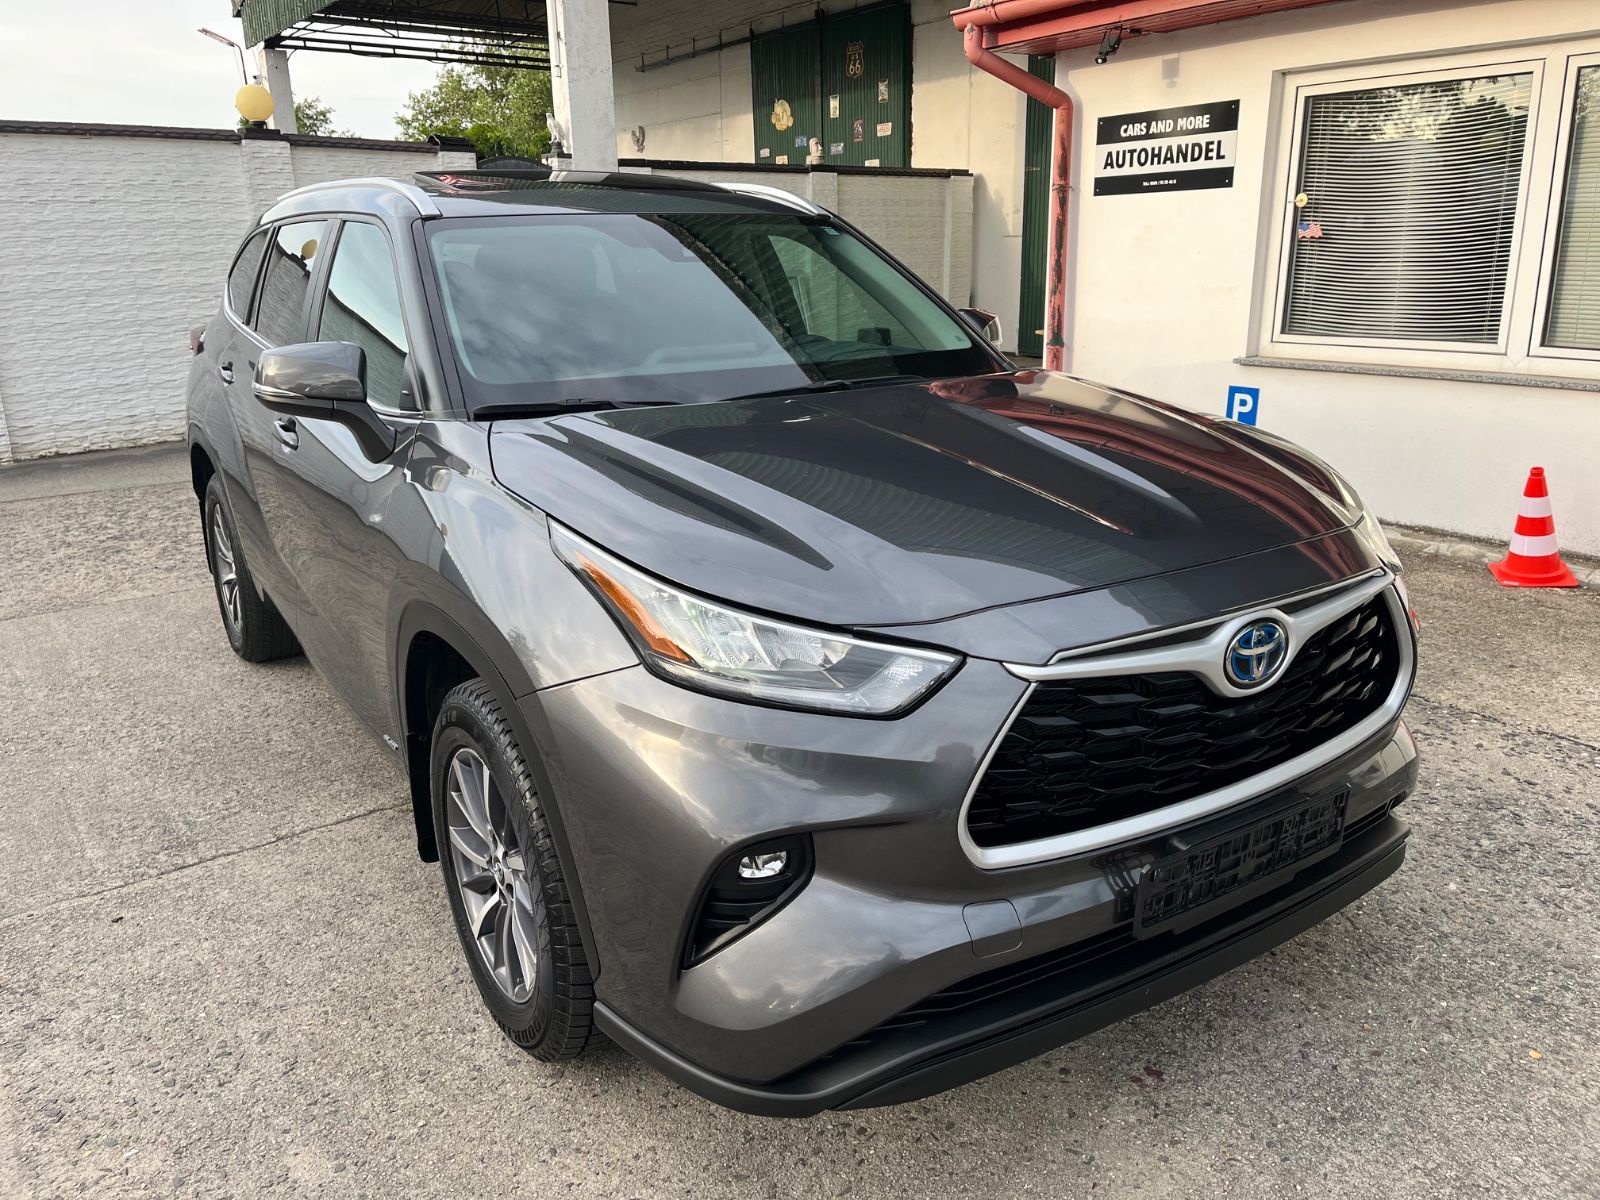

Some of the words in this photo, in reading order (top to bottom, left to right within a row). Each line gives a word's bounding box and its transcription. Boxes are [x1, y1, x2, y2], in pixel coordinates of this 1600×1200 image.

[849, 59, 861, 75] 66
[1120, 122, 1147, 137] CARS
[1148, 119, 1174, 134] AND
[1177, 114, 1210, 131] MORE
[1103, 139, 1225, 170] AUTOHANDEL
[1232, 393, 1253, 421] P
